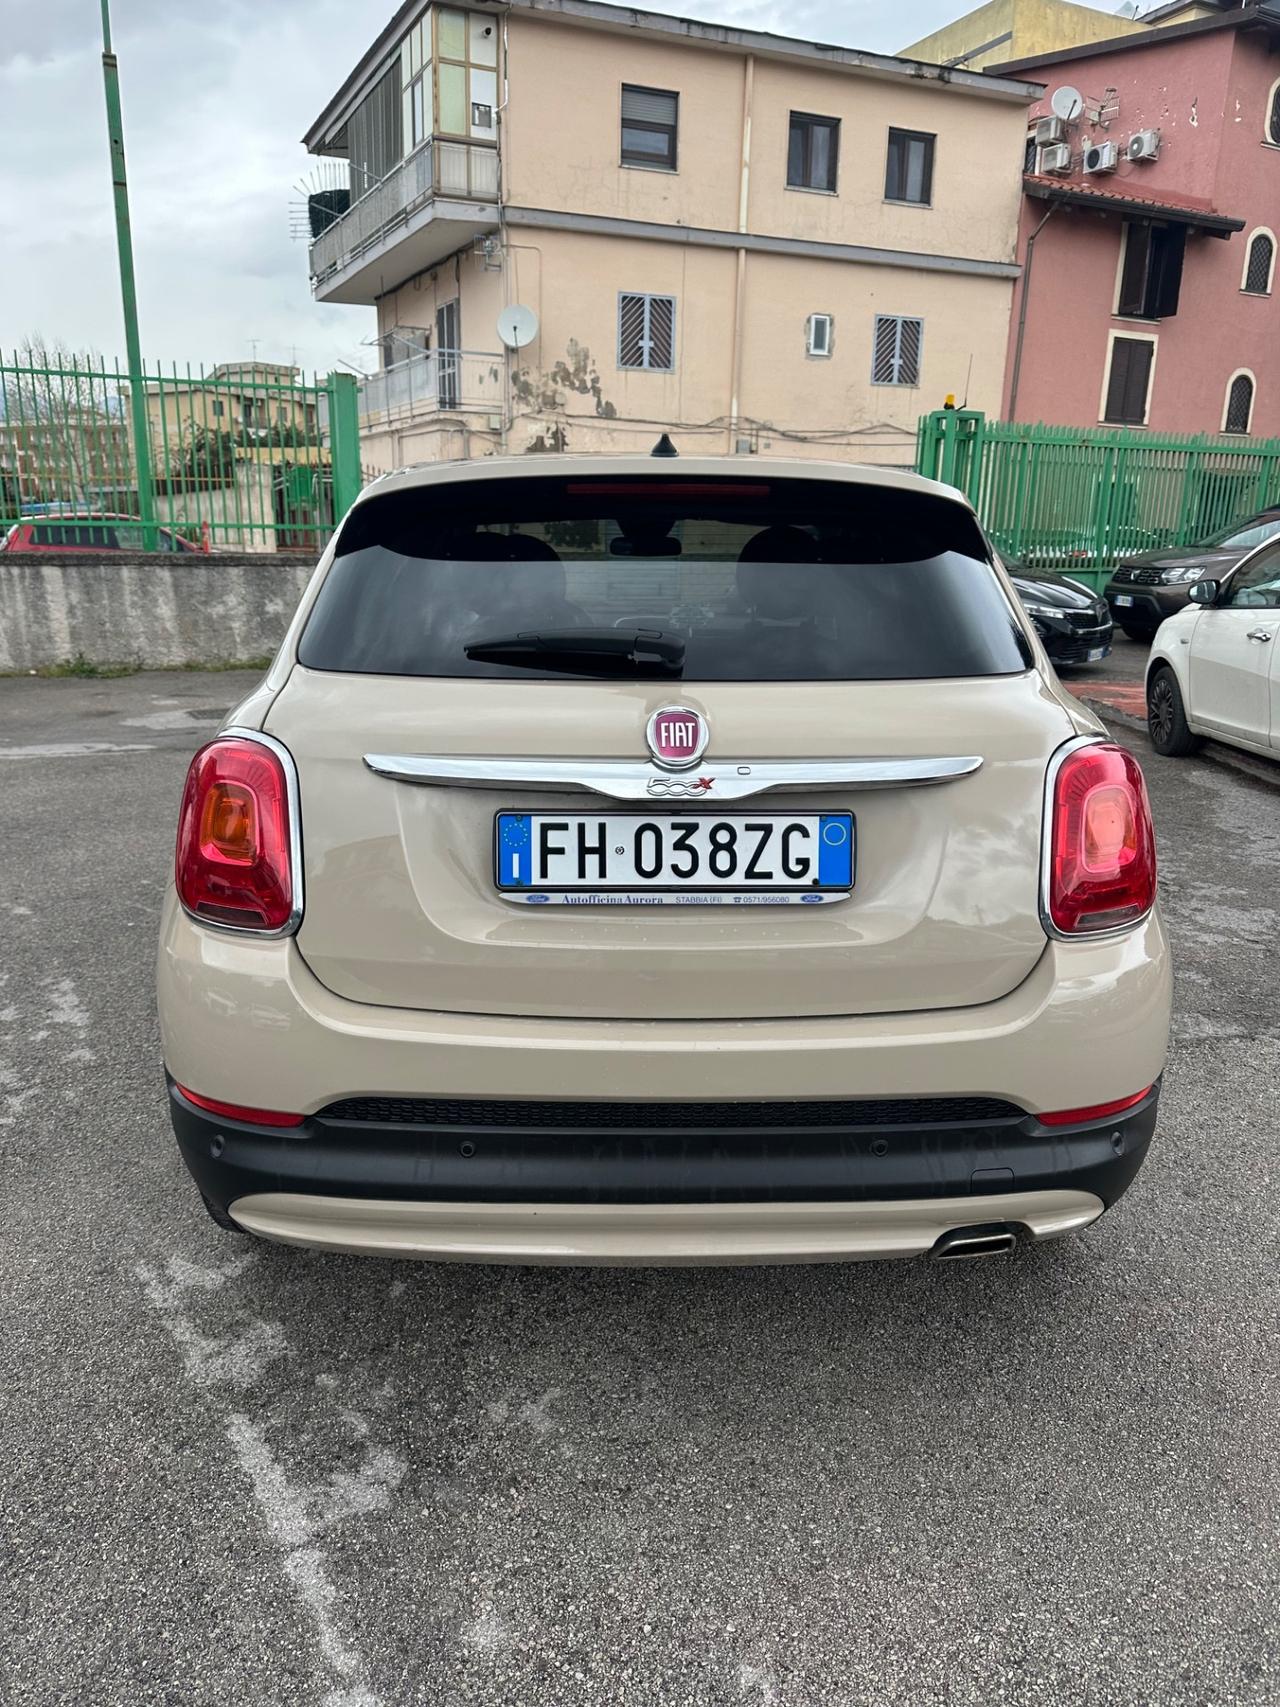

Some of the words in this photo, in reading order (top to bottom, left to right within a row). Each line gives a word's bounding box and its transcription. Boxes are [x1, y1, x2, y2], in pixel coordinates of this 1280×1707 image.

[660, 722, 696, 748] FIAT
[562, 894, 623, 904] Autofficina
[624, 894, 663, 904] Aurora
